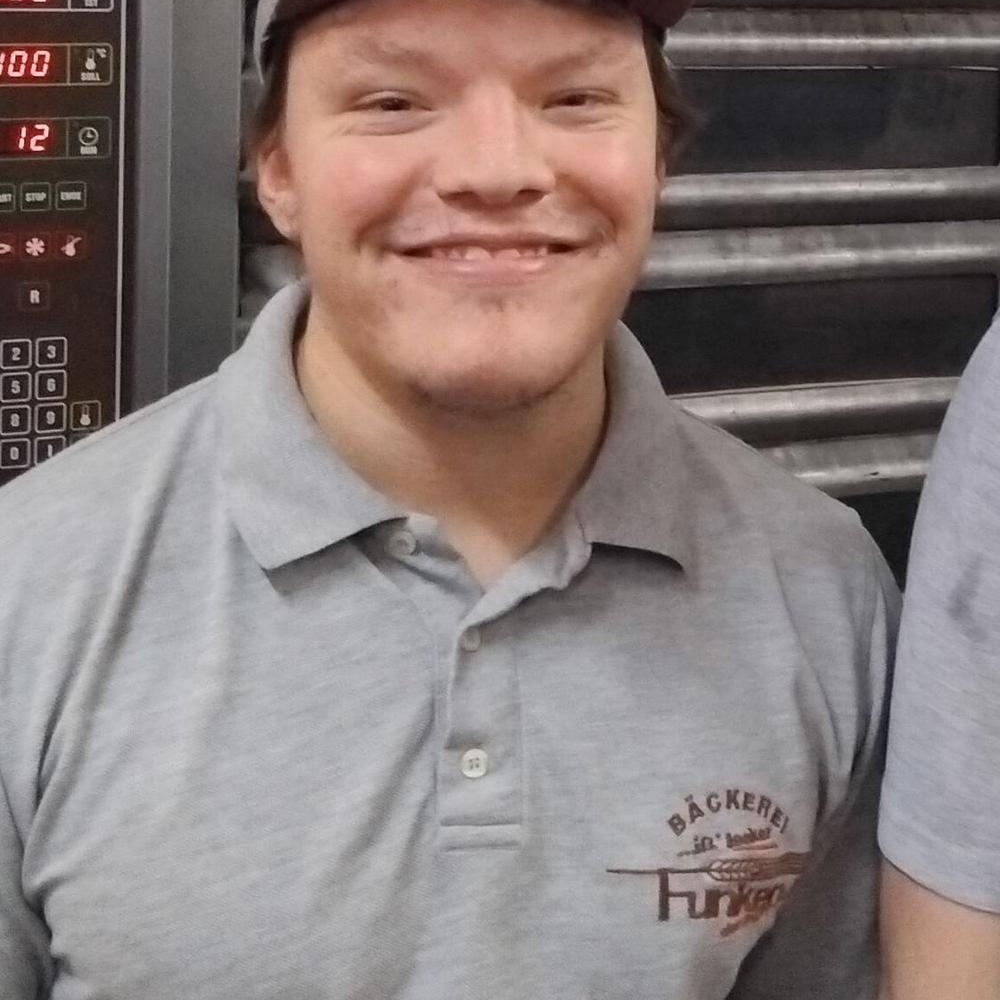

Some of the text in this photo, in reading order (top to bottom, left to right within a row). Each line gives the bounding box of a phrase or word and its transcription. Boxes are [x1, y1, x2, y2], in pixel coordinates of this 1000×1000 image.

[18, 124, 50, 151] 12
[11, 344, 57, 361] 2 3
[10, 377, 56, 394] 5 6
[10, 410, 56, 427] 8 9
[667, 789, 789, 837] BÄCKEREI
